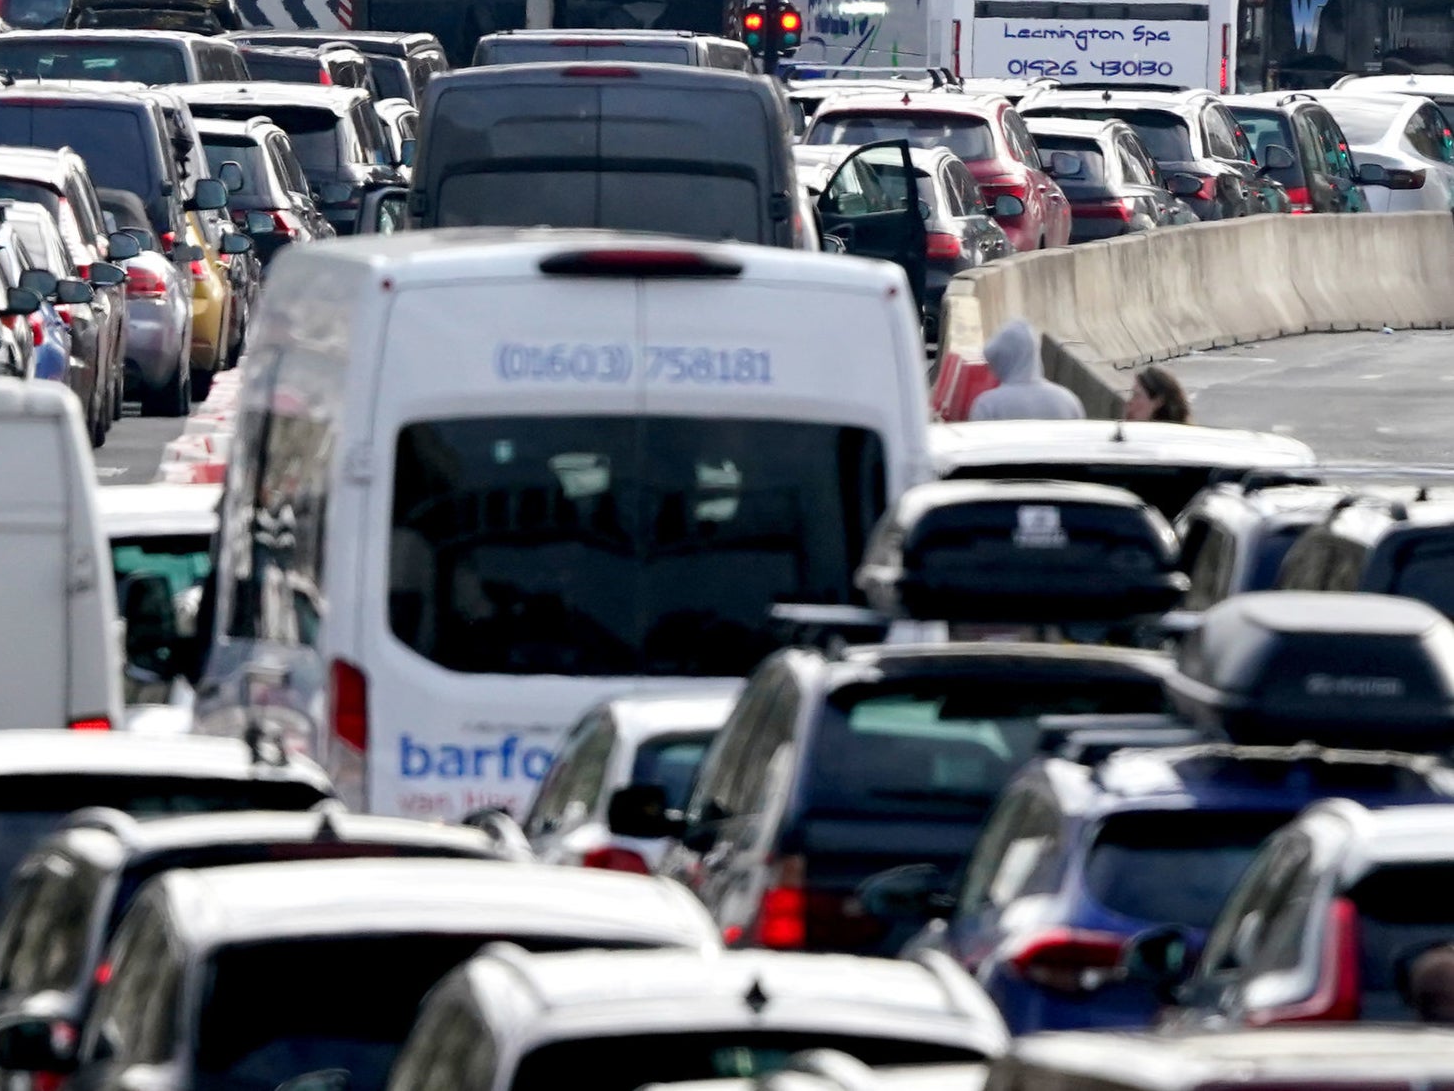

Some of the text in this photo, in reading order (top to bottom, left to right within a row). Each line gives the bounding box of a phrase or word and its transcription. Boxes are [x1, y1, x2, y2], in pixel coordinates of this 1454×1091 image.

[1007, 59, 1173, 77] 01926 430130
[499, 342, 772, 385] (01603) 758181
